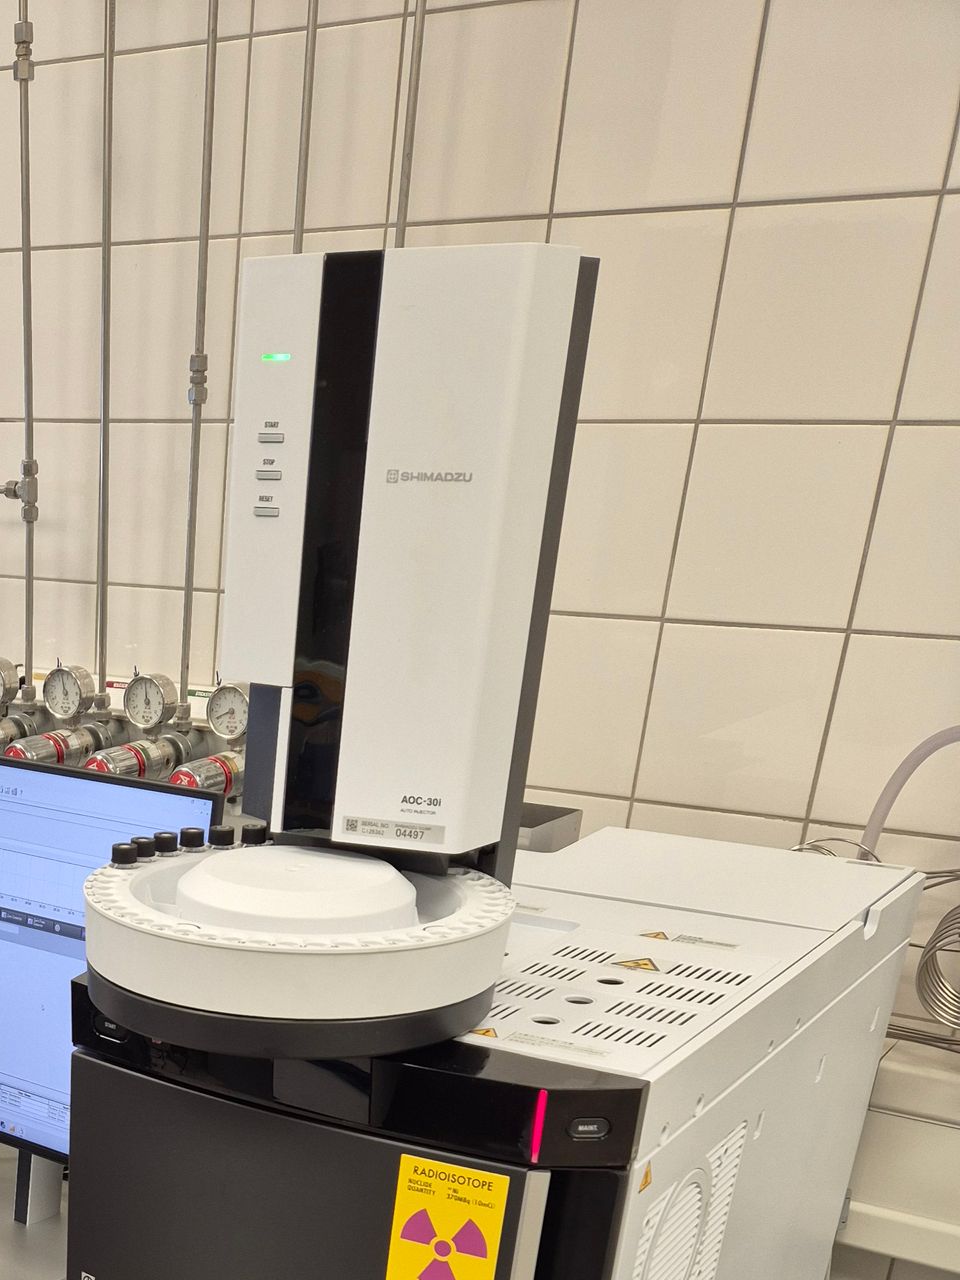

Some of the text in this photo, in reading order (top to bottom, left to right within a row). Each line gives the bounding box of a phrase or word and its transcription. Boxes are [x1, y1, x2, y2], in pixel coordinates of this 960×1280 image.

[400, 471, 473, 483] SHIMADZU
[400, 795, 442, 807] AOC-30i
[361, 820, 380, 828] SERIAL
[395, 828, 425, 840] 04497
[408, 1178, 433, 1188] NUCLIDE
[413, 1165, 494, 1191] RADIOISOTOPE
[407, 1184, 436, 1196] QUANTITY
